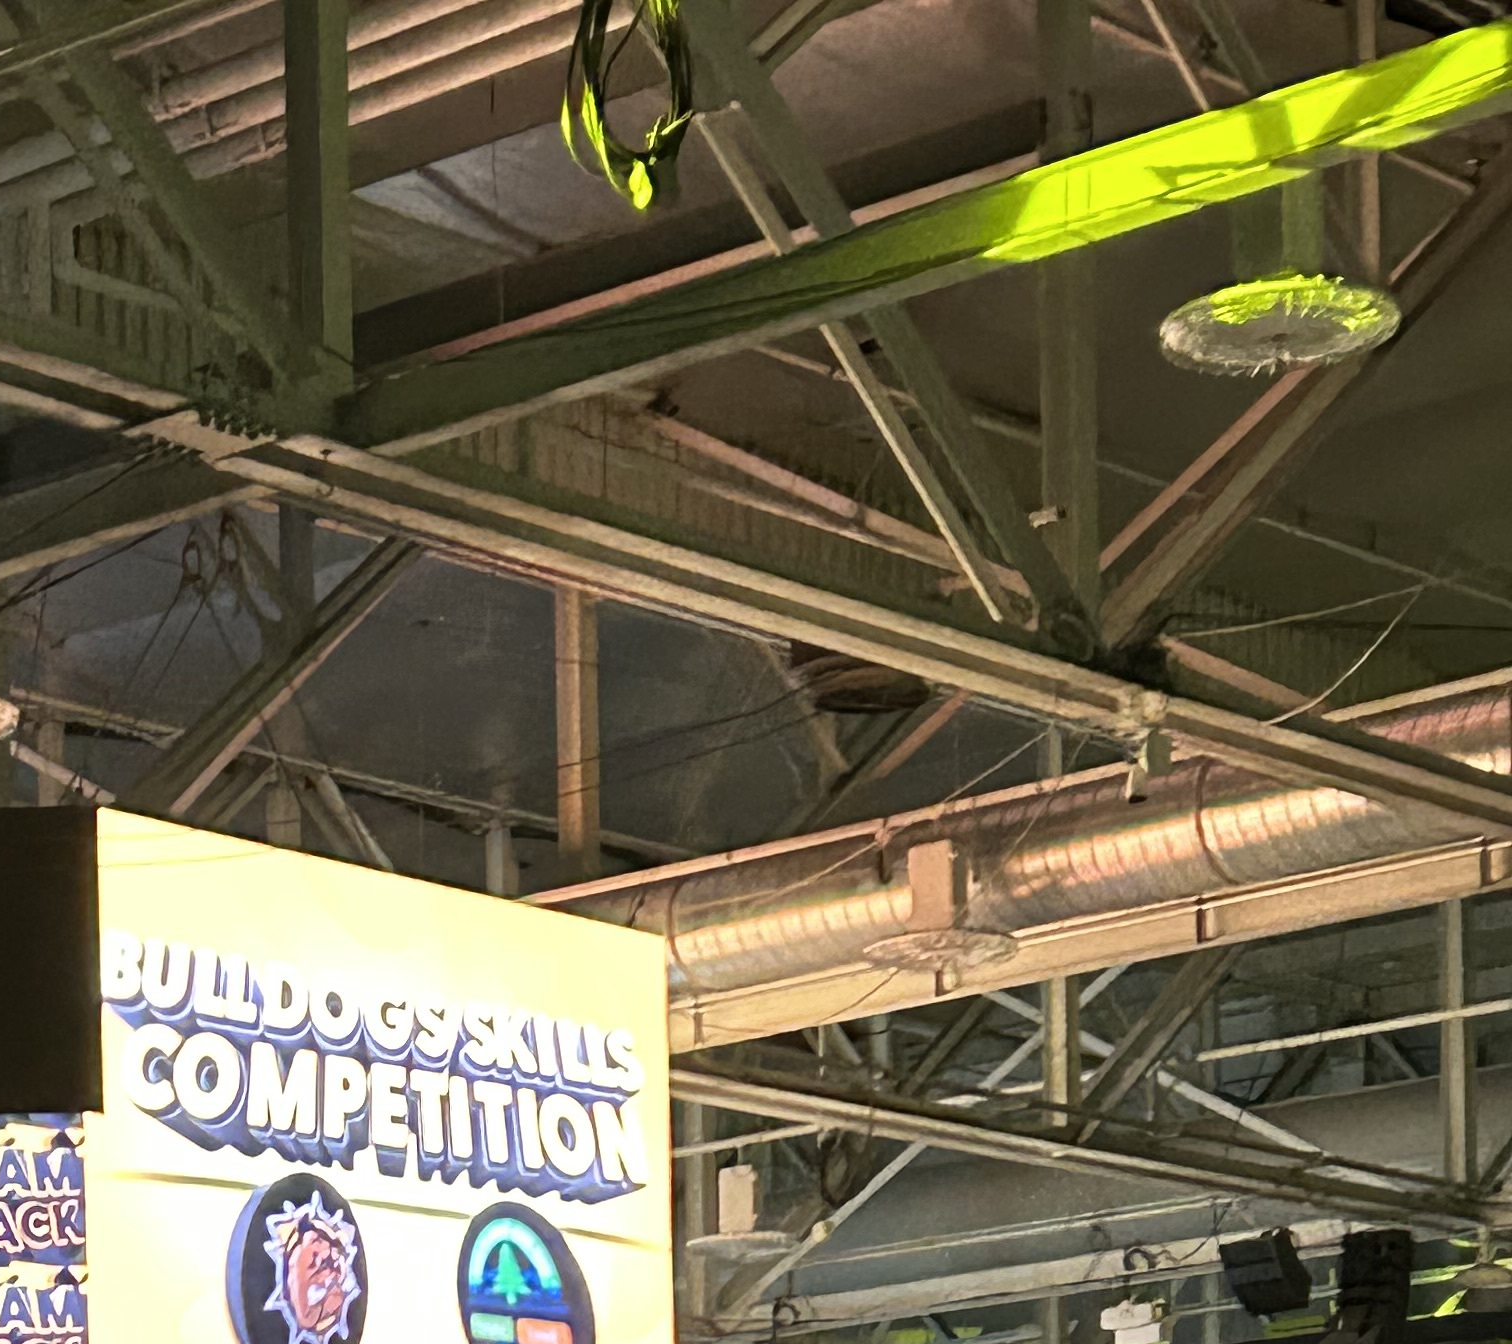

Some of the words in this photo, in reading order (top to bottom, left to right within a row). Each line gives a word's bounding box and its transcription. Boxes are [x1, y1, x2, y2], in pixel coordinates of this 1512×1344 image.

[101, 932, 456, 1078] BULLDOGS
[454, 998, 646, 1098] SKILLS
[124, 1022, 646, 1204] COMPETITION
